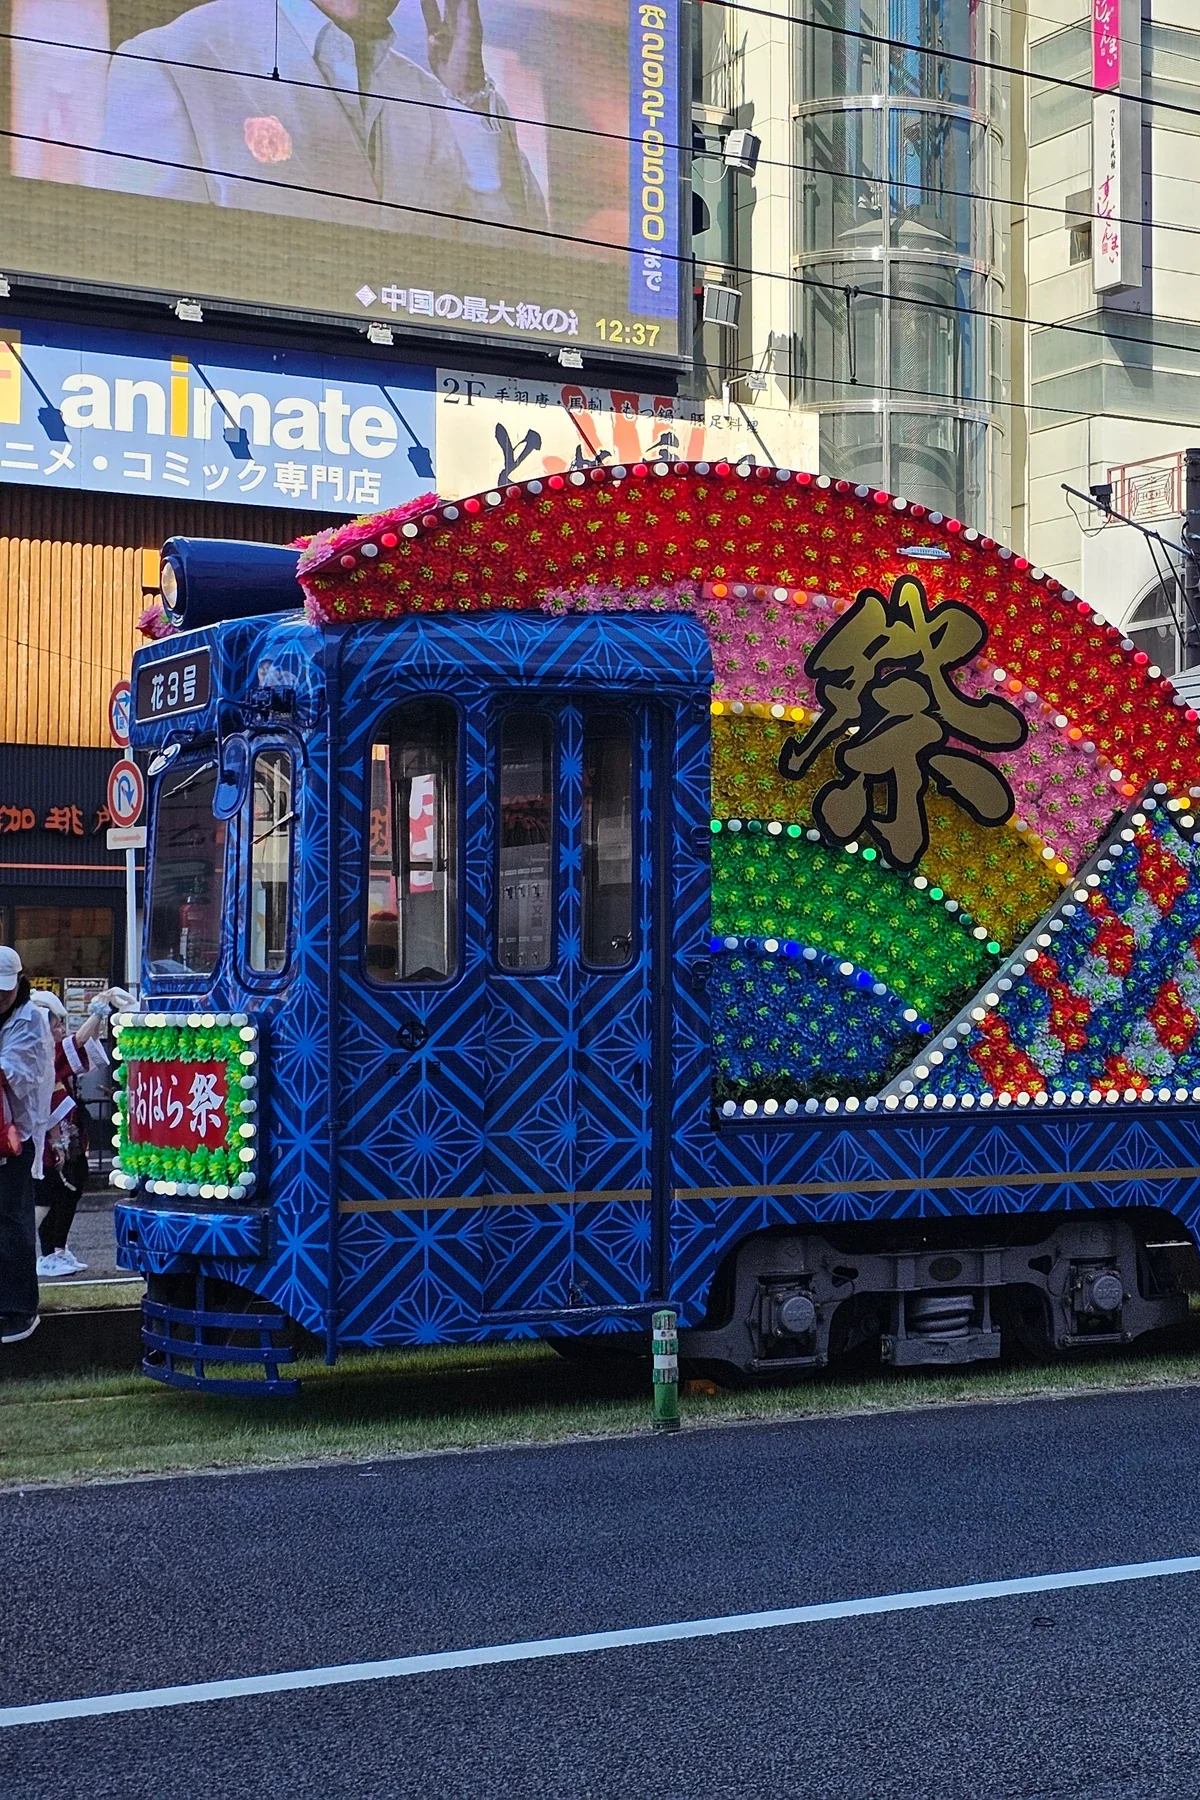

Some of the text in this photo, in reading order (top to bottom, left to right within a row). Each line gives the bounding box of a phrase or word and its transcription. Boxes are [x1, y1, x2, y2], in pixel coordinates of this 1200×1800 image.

[596, 318, 660, 347] 12:37
[61, 354, 399, 460] animate
[443, 377, 486, 406] 2F
[151, 664, 196, 711] 花3号
